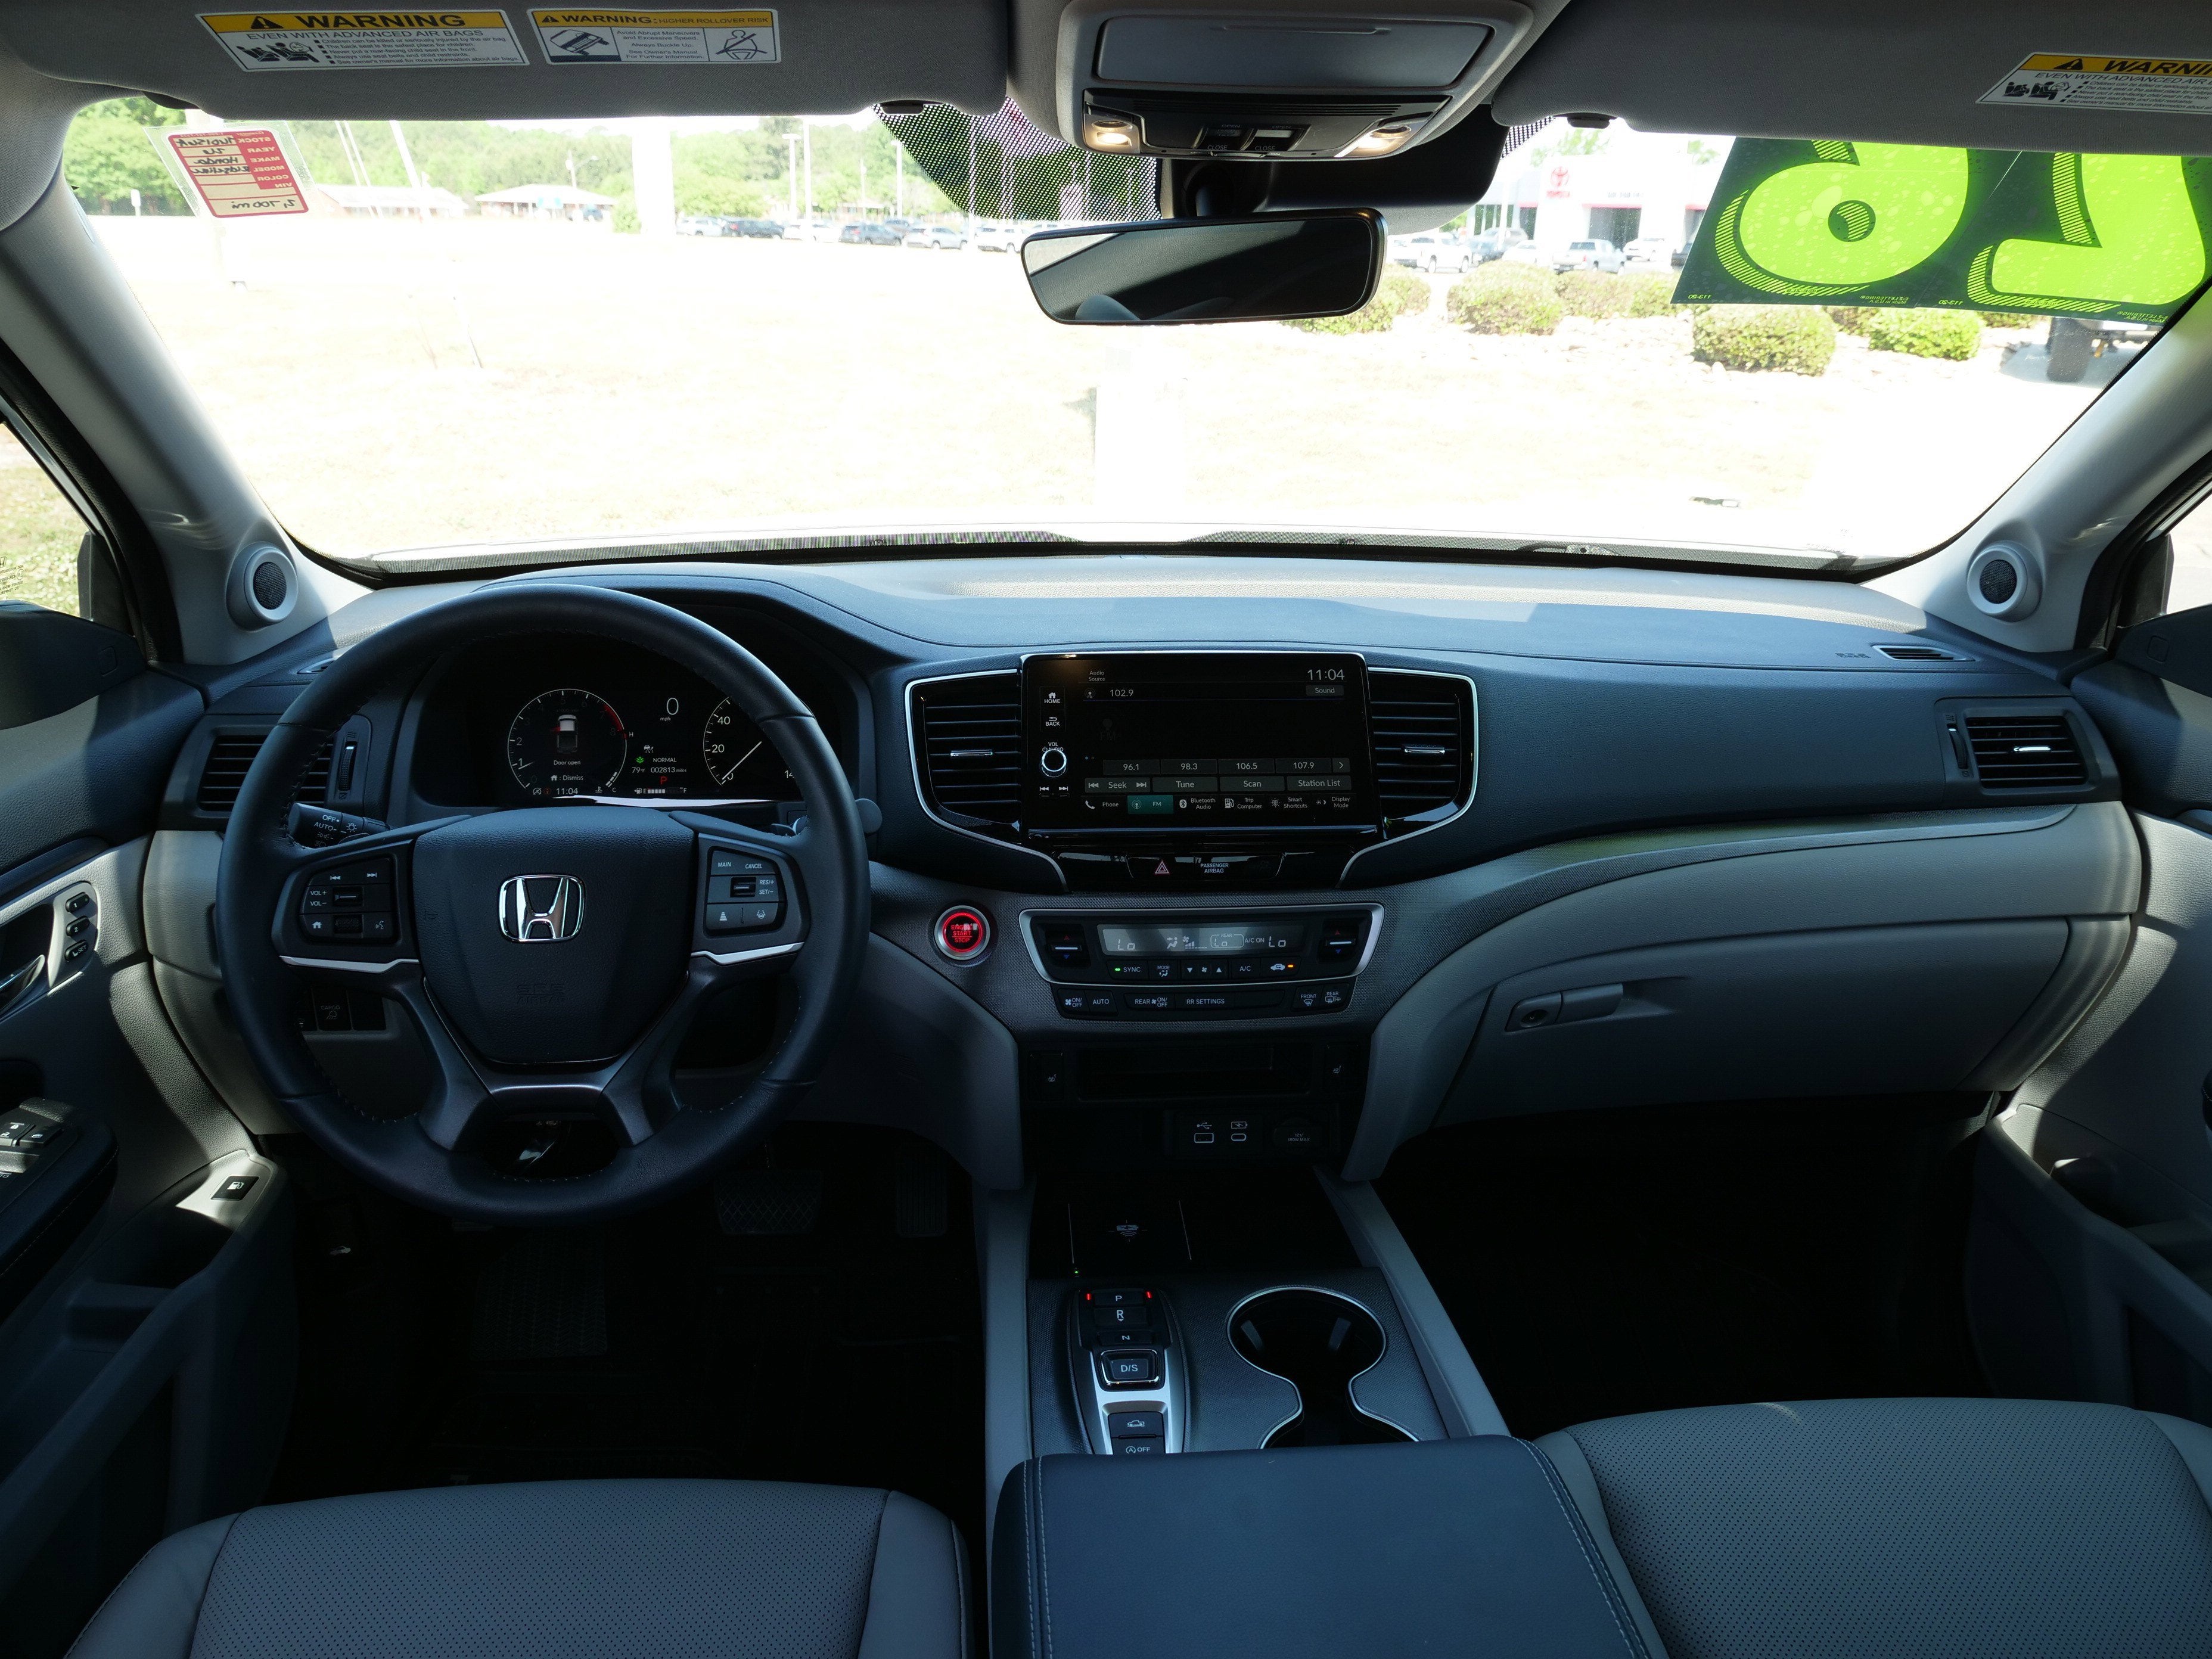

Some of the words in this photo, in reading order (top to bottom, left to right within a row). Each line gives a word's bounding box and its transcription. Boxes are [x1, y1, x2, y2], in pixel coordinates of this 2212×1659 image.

[295, 15, 465, 28] WARNING
[2110, 74, 2186, 83] ADVANCED
[1307, 669, 1345, 680] 11:04
[1110, 688, 1134, 697] 102.9
[666, 697, 679, 715] 0
[717, 716, 731, 725] 40
[516, 737, 523, 745] 2
[712, 744, 725, 753] 20
[518, 757, 523, 766] 1
[659, 775, 667, 785] P
[322, 814, 336, 822] OFF
[313, 822, 334, 831] AUTO
[1117, 939, 1135, 950] Lo
[1214, 938, 1228, 947] Lo
[1268, 936, 1287, 947] Lo
[1116, 1309, 1124, 1319] R
[1120, 1364, 1138, 1372] D/S
